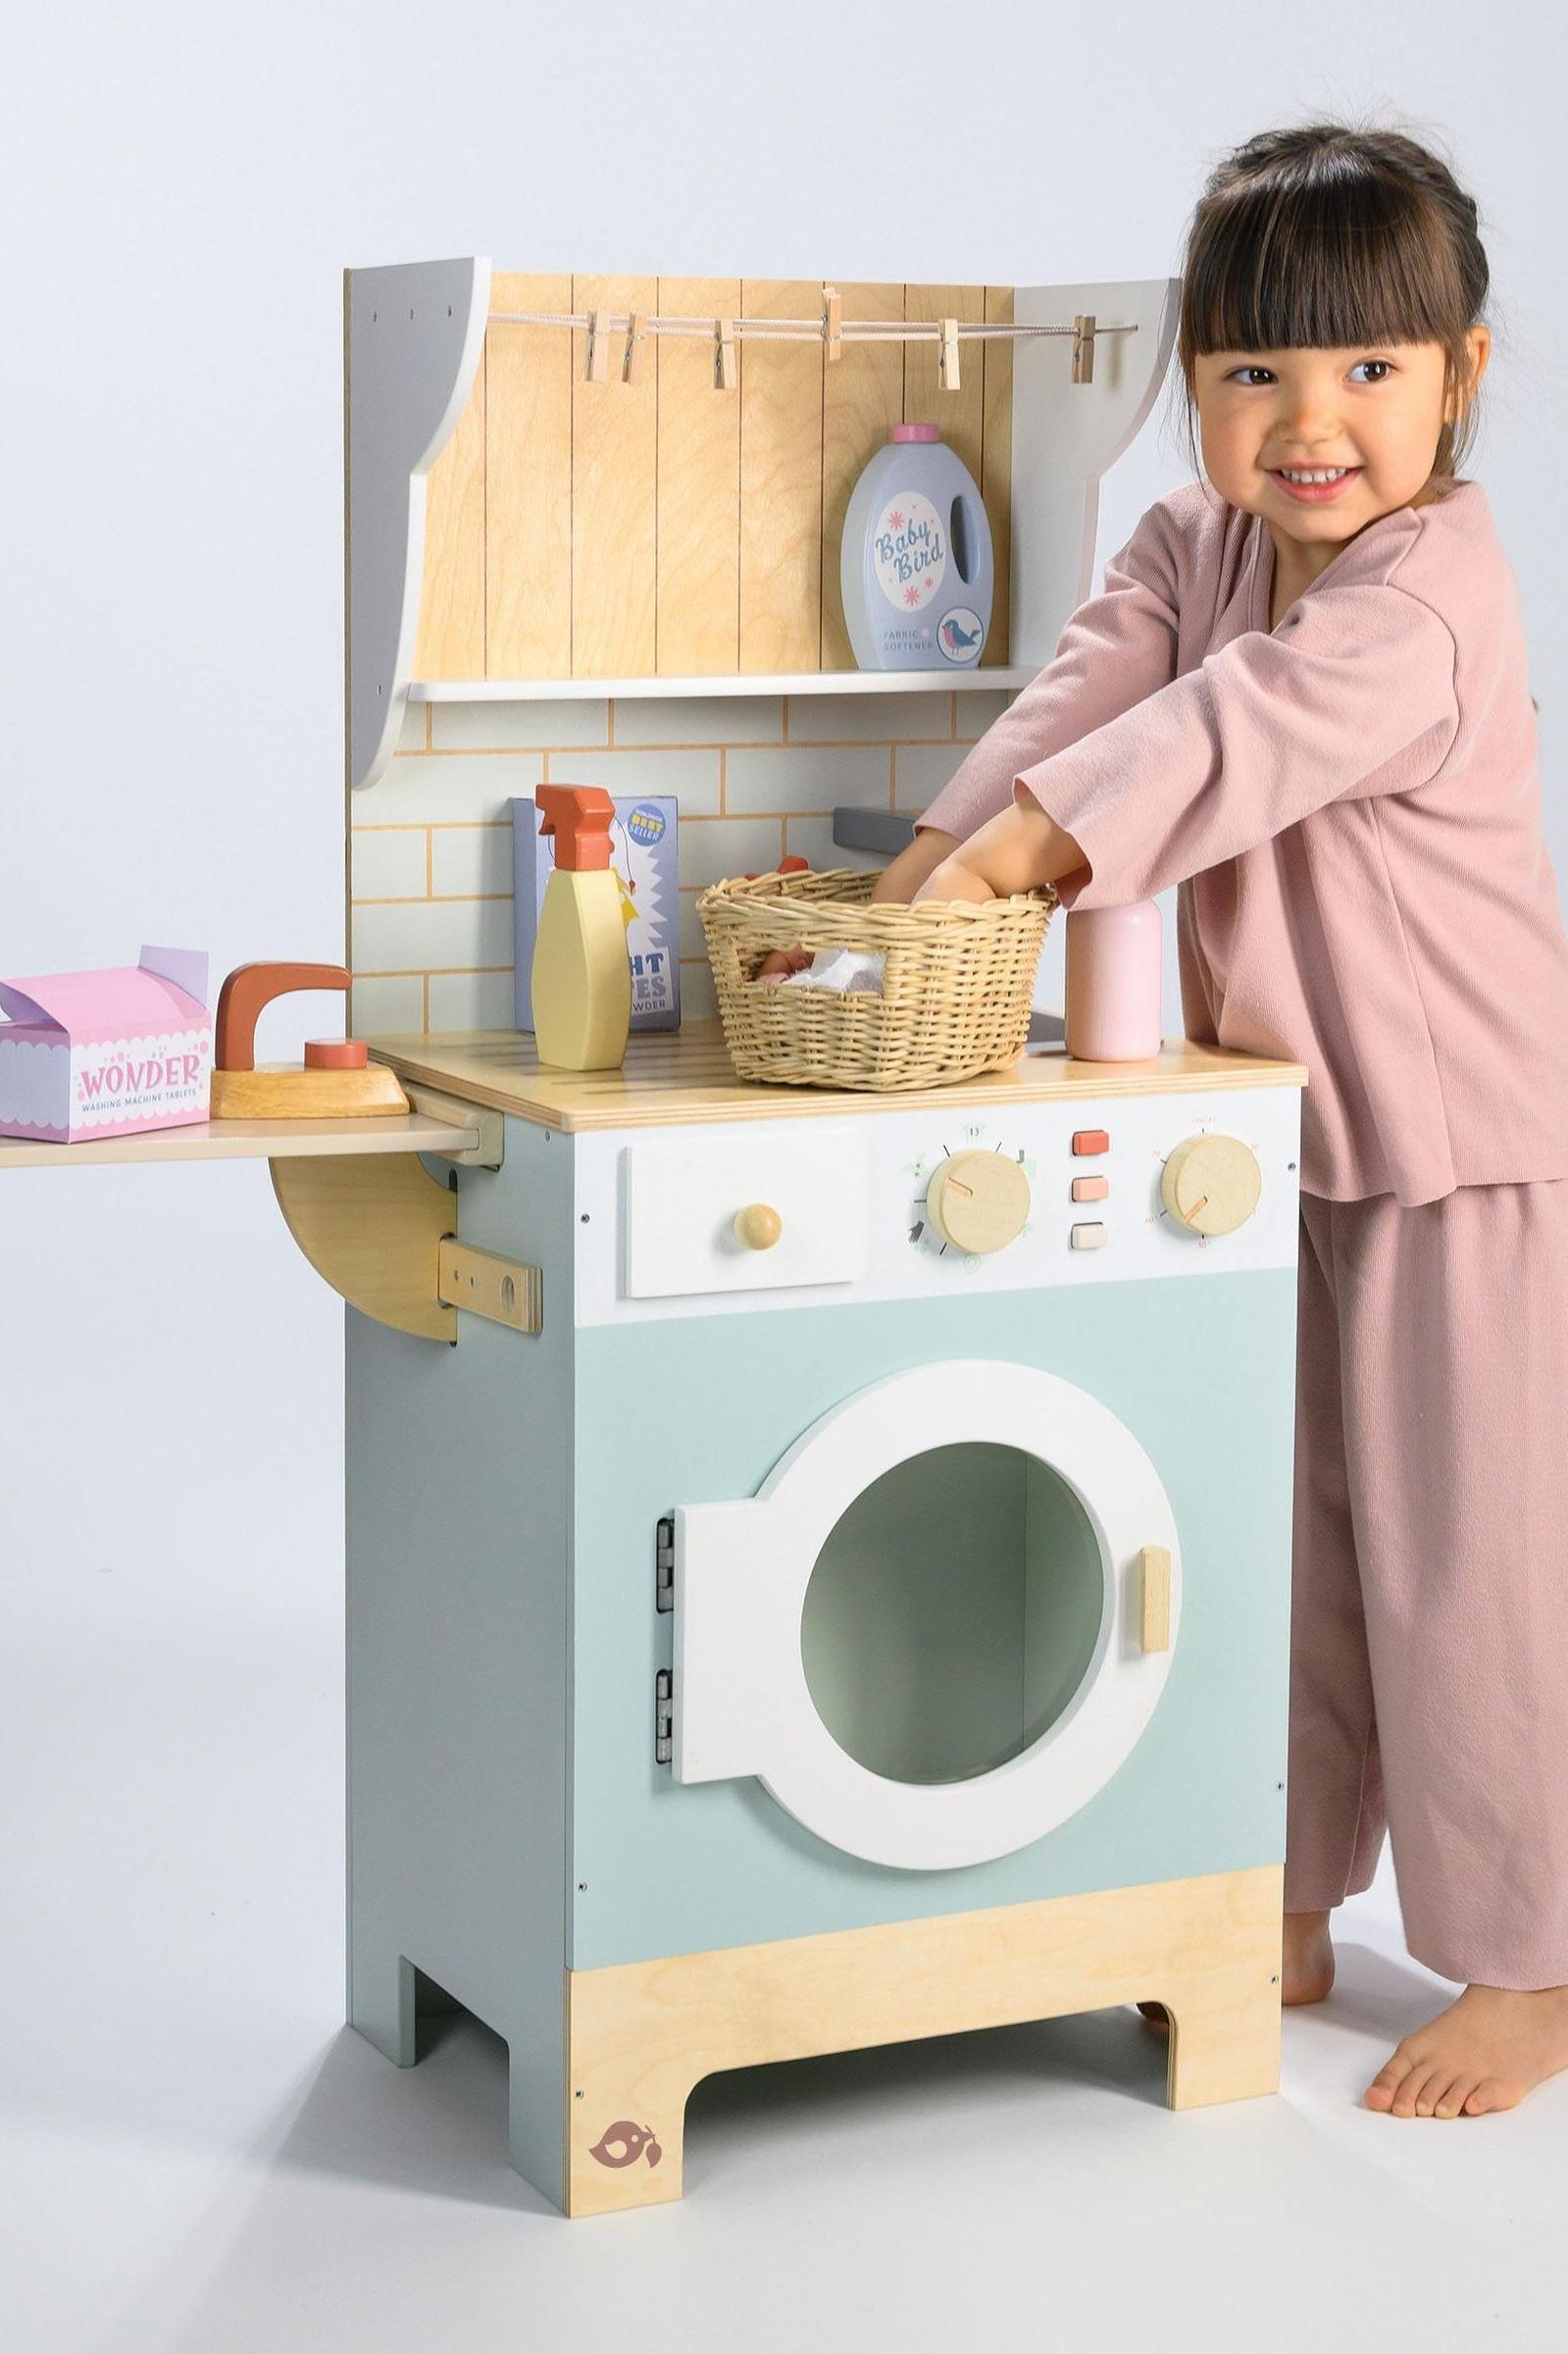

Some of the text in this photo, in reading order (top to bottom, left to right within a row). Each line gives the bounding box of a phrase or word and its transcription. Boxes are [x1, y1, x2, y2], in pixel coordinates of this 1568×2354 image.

[876, 518, 931, 563] Baby
[894, 534, 943, 584] Bird
[884, 630, 919, 640] FABRIC
[884, 641, 933, 650] SOFTENER
[629, 824, 659, 841] SELLER
[632, 999, 666, 1011] WDER
[80, 1054, 200, 1100] WONDER
[81, 1088, 196, 1112] WASHING MACHINE TABLETS
